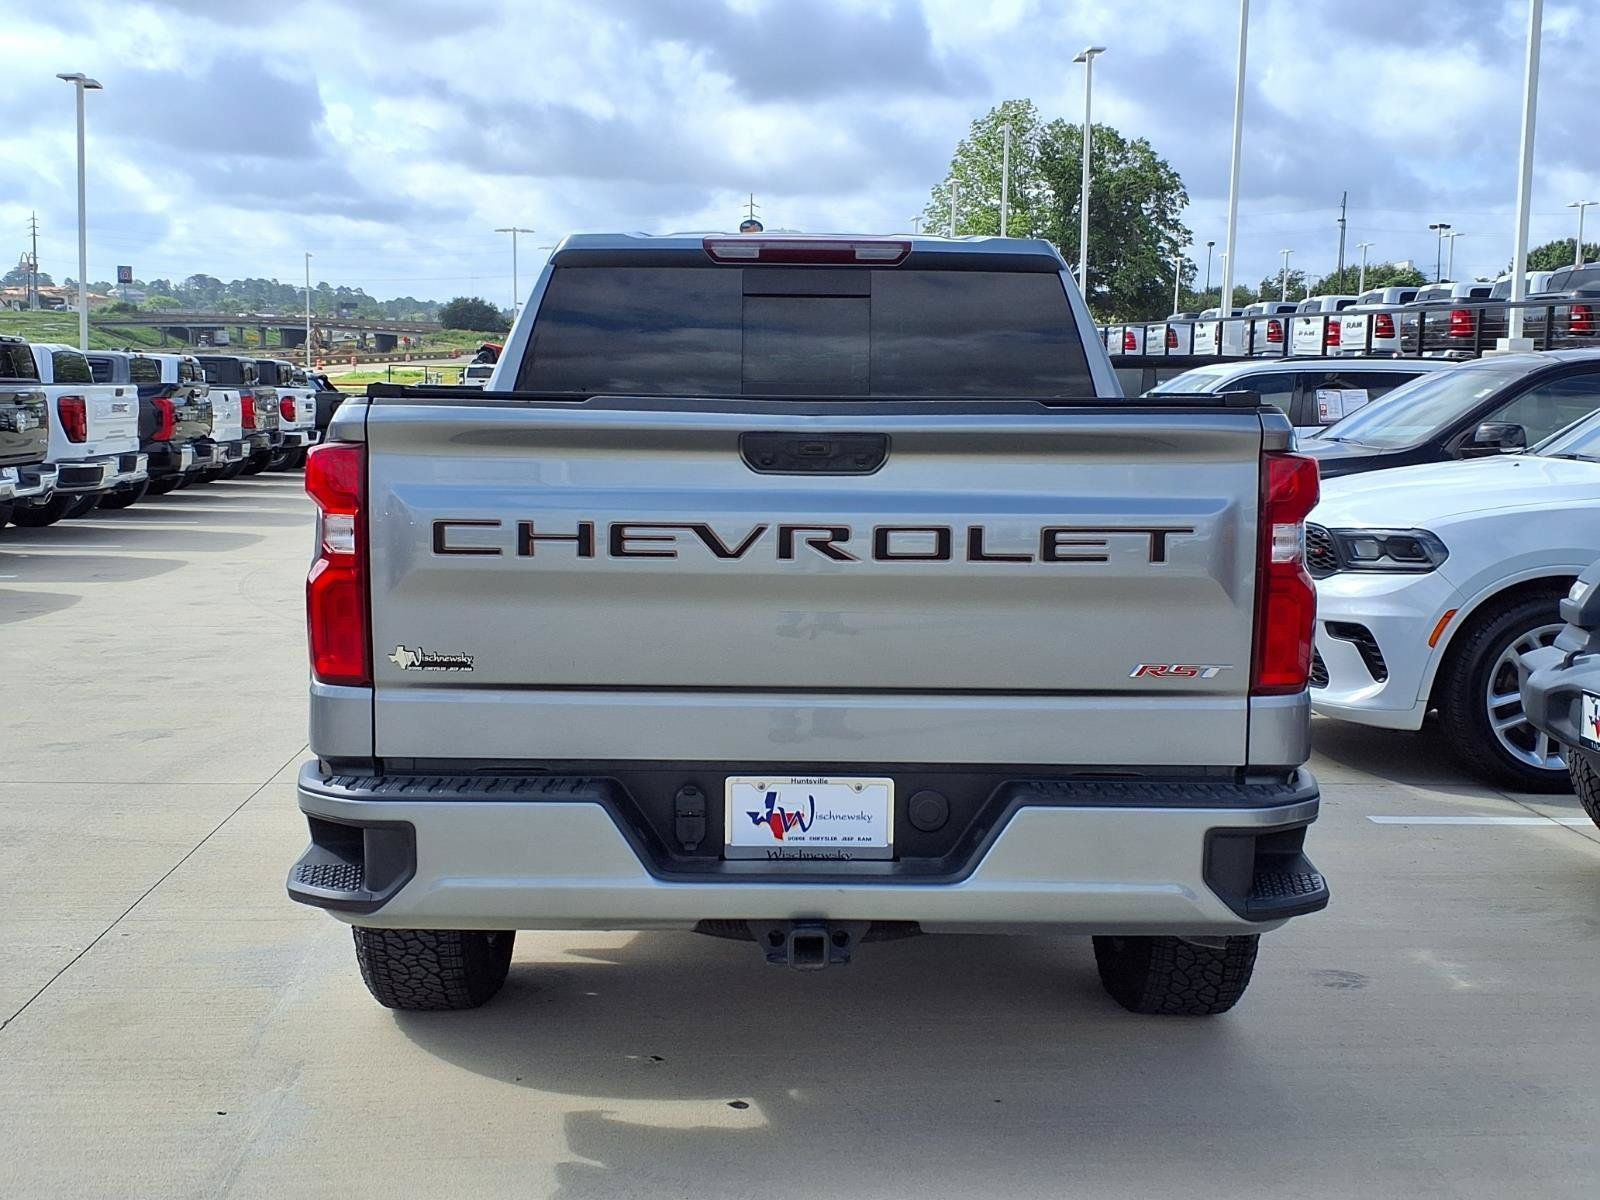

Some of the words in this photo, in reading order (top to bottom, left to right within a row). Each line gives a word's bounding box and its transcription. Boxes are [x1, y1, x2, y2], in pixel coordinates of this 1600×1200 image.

[1346, 321, 1363, 329] RAM
[431, 518, 1196, 564] CHEVROLET
[1129, 663, 1233, 678] RST
[790, 777, 829, 785] Huntsville
[777, 794, 873, 833] Wischnewsky
[766, 846, 853, 860] Wischnewsky
